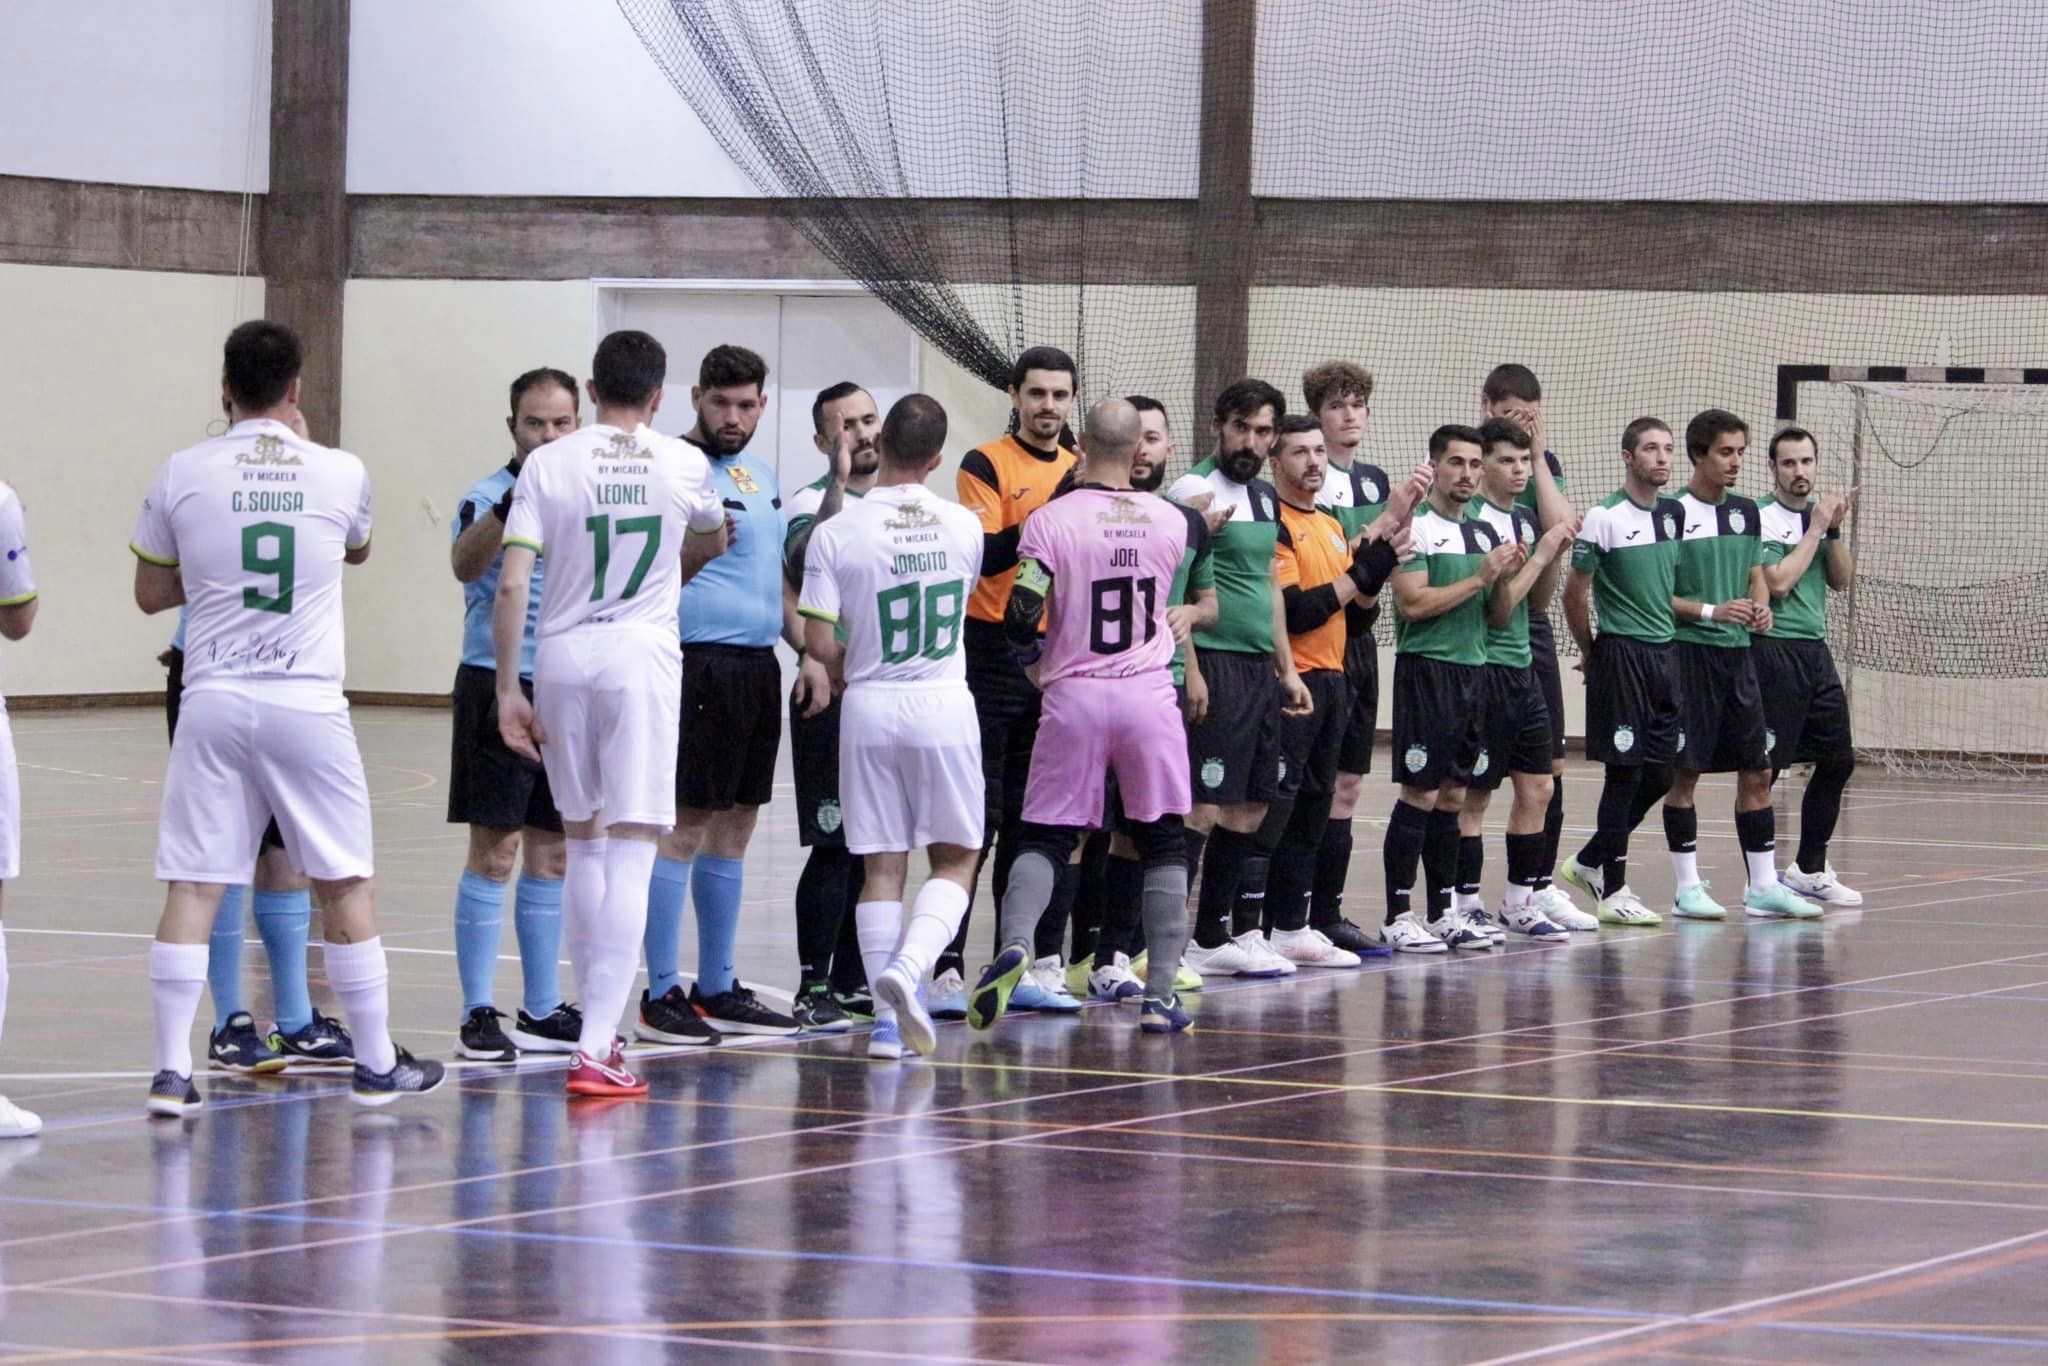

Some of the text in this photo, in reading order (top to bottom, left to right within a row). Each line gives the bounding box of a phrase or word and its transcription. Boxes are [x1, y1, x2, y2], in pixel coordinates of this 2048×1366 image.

[242, 472, 297, 481] BY MICAELA
[612, 465, 649, 474] MICAELA
[232, 491, 304, 512] G.SOUSA
[597, 484, 648, 505] LEONEL
[905, 532, 938, 543] MICAELA
[242, 521, 295, 614] 9
[586, 513, 662, 602] 17
[890, 551, 947, 575] JORGITO
[1110, 548, 1139, 567] JOEL
[877, 578, 964, 664] 88
[1089, 576, 1156, 655] 81
